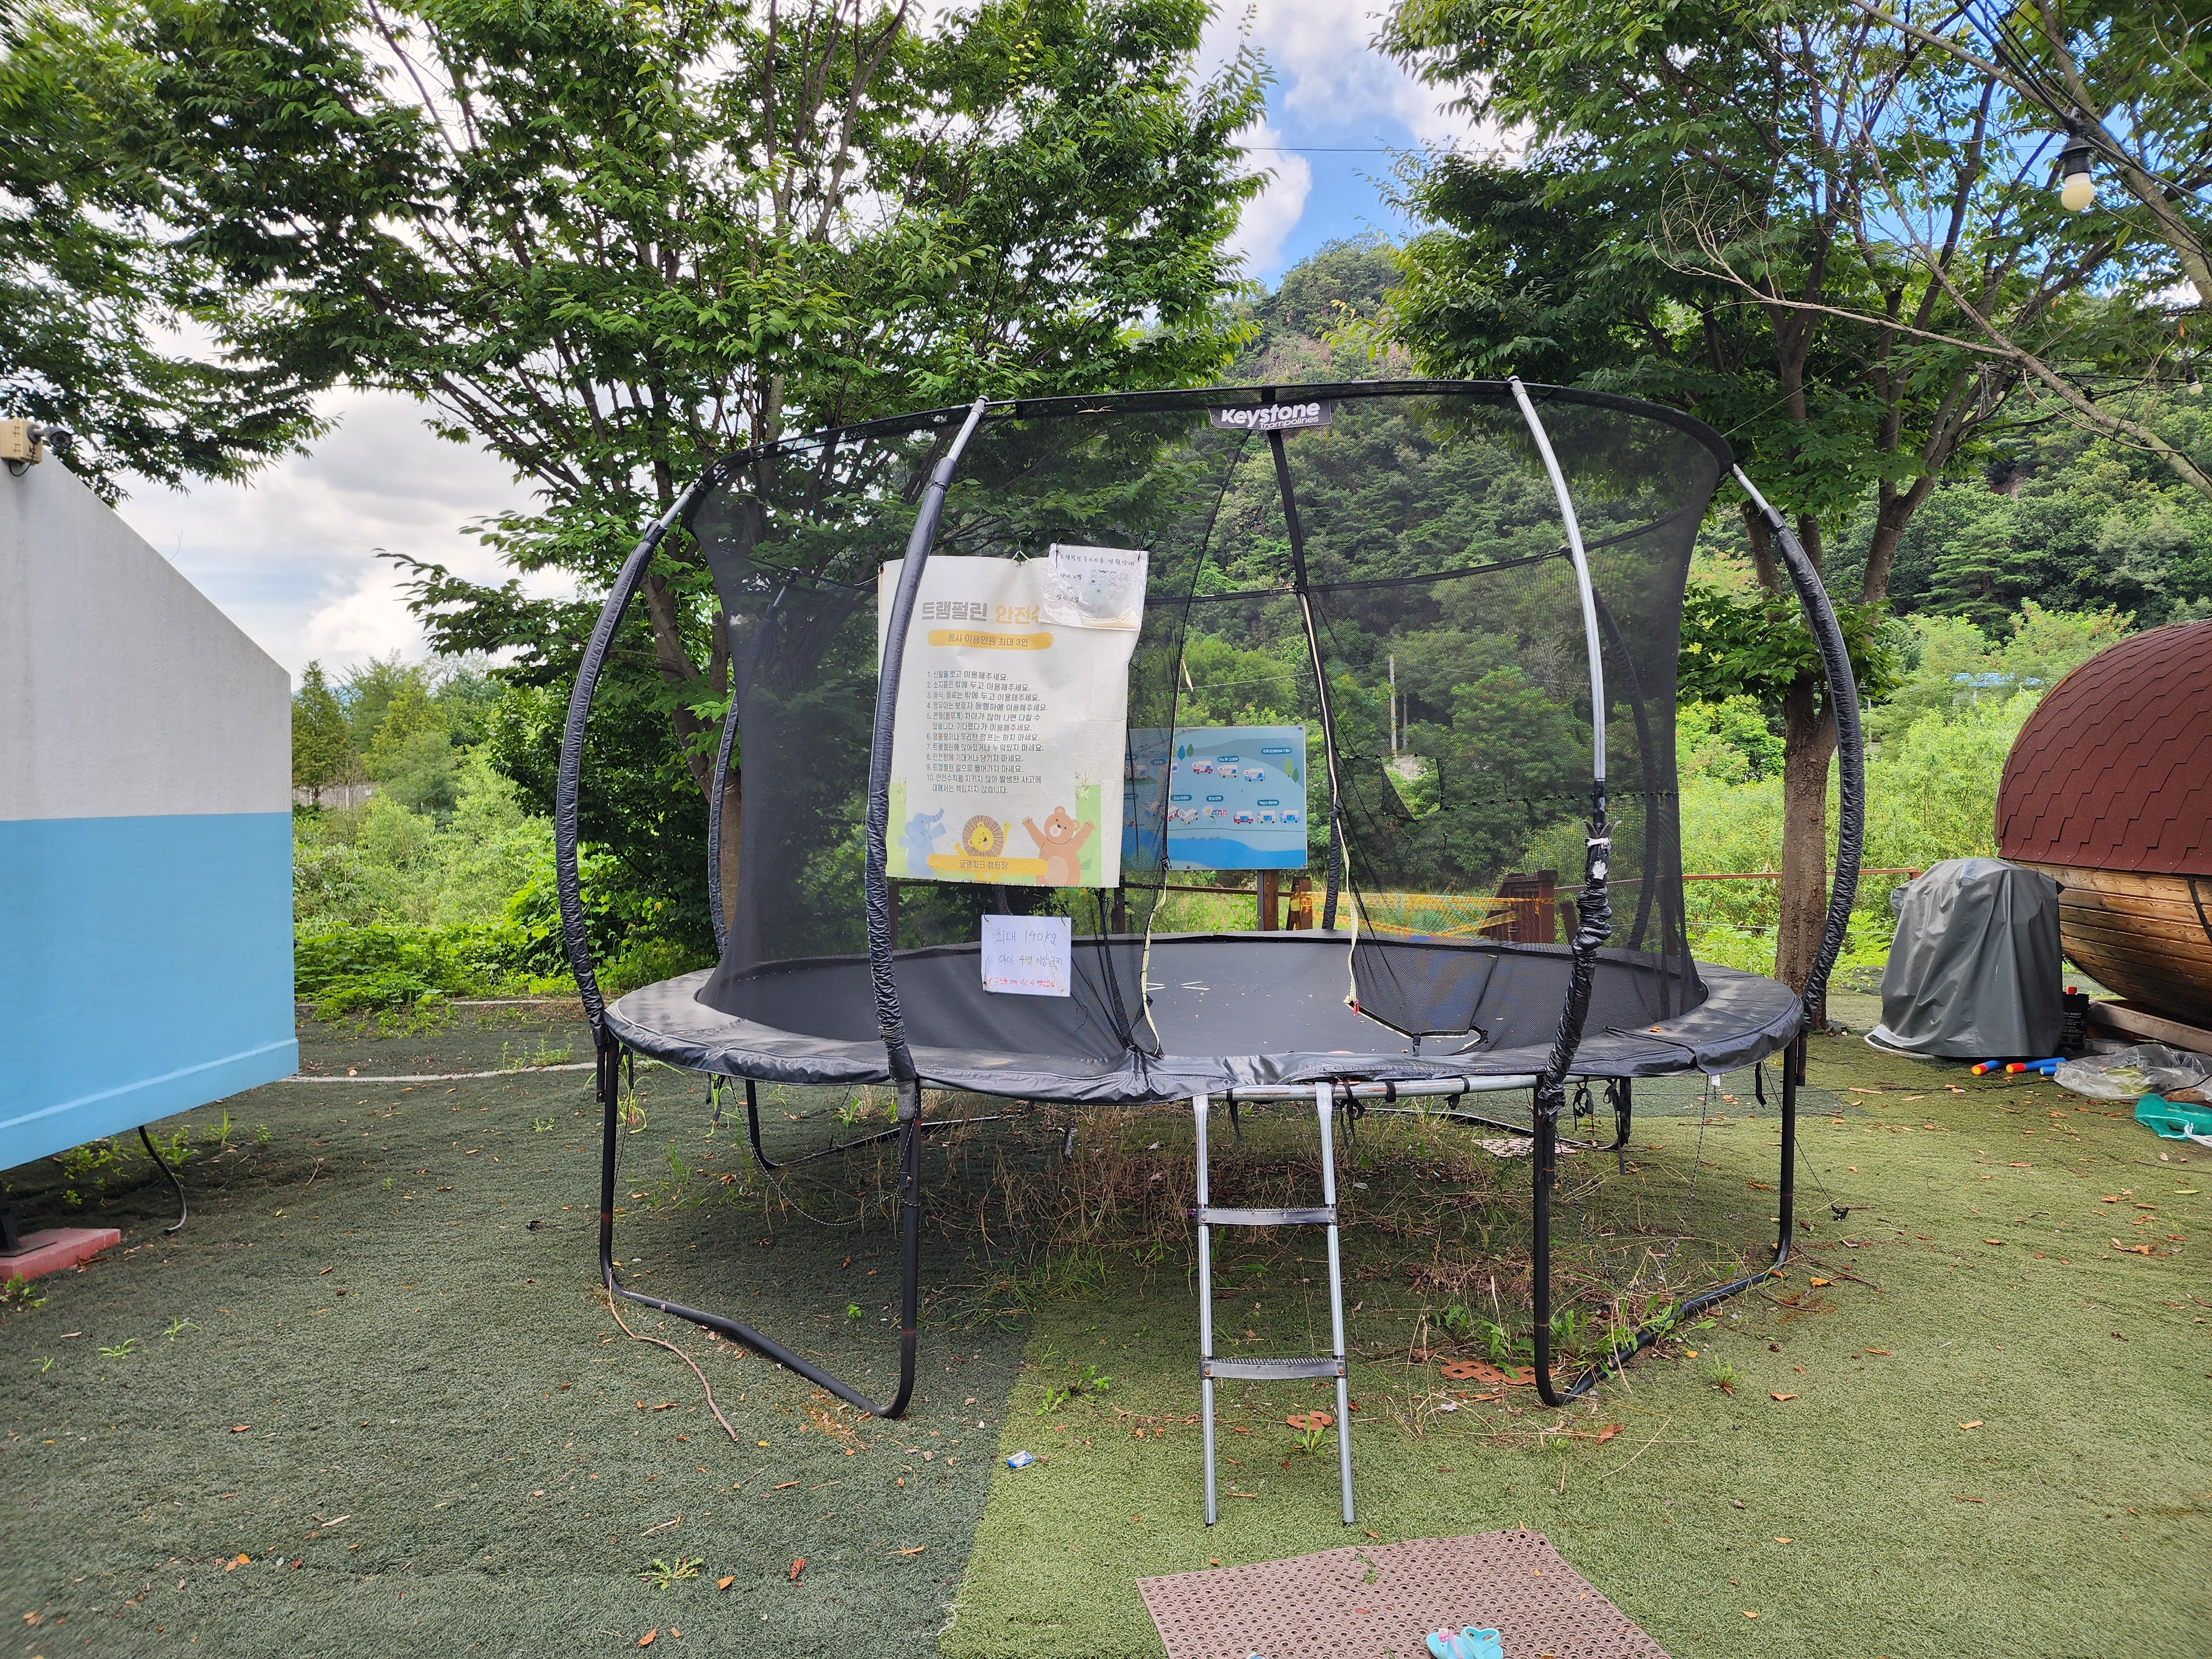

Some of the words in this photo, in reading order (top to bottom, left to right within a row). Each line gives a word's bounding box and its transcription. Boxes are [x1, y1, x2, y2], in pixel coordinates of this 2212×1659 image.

[1221, 402, 1321, 427] Keystone
[1259, 416, 1319, 429] Trampolines
[922, 601, 988, 622] 트램펄린
[995, 604, 1040, 625] 안전수
[948, 634, 962, 642] 동시
[965, 634, 996, 645] 이용인원
[1016, 638, 1028, 646] 3인
[933, 670, 948, 679] 신발을
[964, 671, 1009, 681] 이용해주세요.
[987, 683, 1030, 691] 이용해주세요.
[975, 702, 1003, 711] 동행하에
[957, 723, 987, 731] 기다렸다가
[990, 723, 1032, 732] 이용해주세요.
[993, 744, 1019, 752] 누워있지
[960, 860, 985, 868] 글램파크
[988, 861, 1008, 870] 캠핑장
[994, 928, 1016, 945] 최대
[999, 954, 1013, 964] 아이
[1019, 956, 1032, 965] 4명
